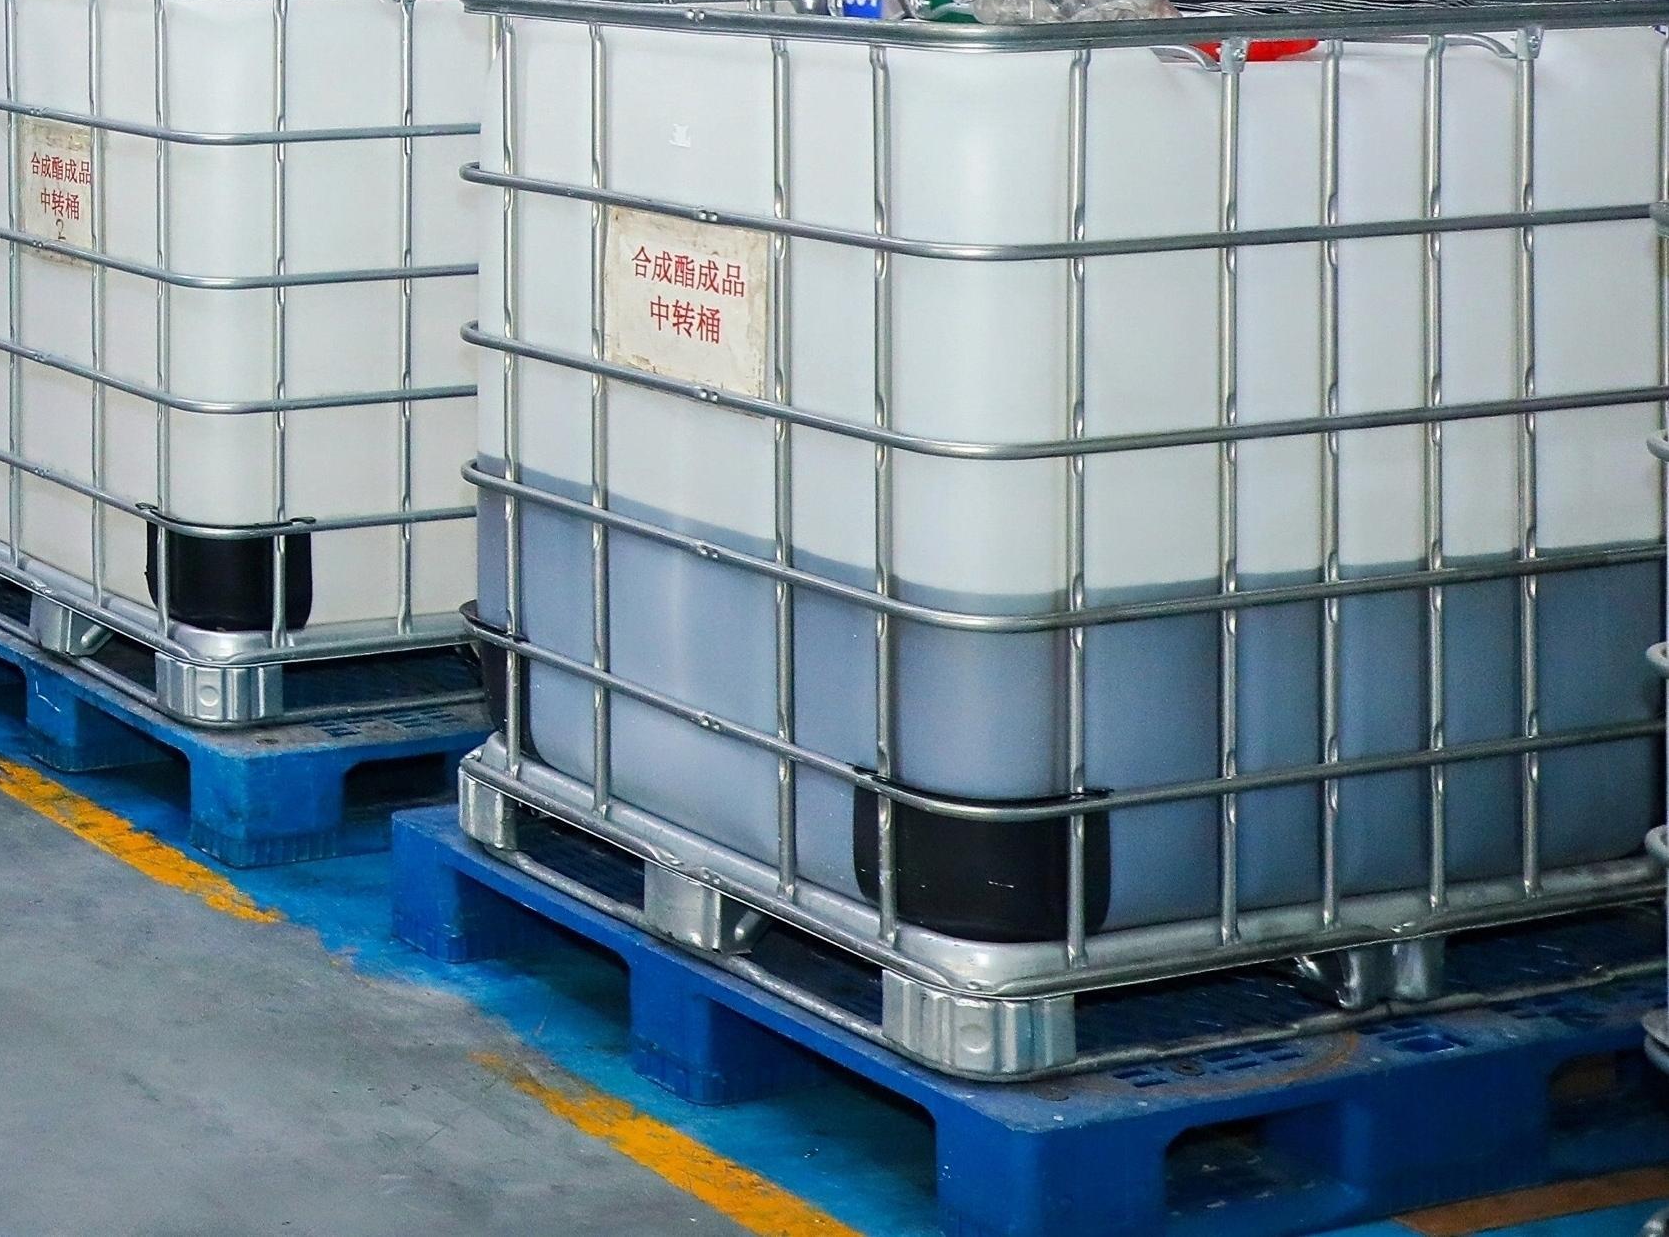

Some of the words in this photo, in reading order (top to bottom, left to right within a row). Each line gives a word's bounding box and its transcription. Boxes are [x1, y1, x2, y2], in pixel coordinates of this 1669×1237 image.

[31, 151, 91, 184] 合成酯成品
[41, 188, 80, 220] 中转桶
[55, 218, 67, 240] 2
[632, 246, 746, 298] 合成酯成品
[650, 295, 721, 344] 中转桶
